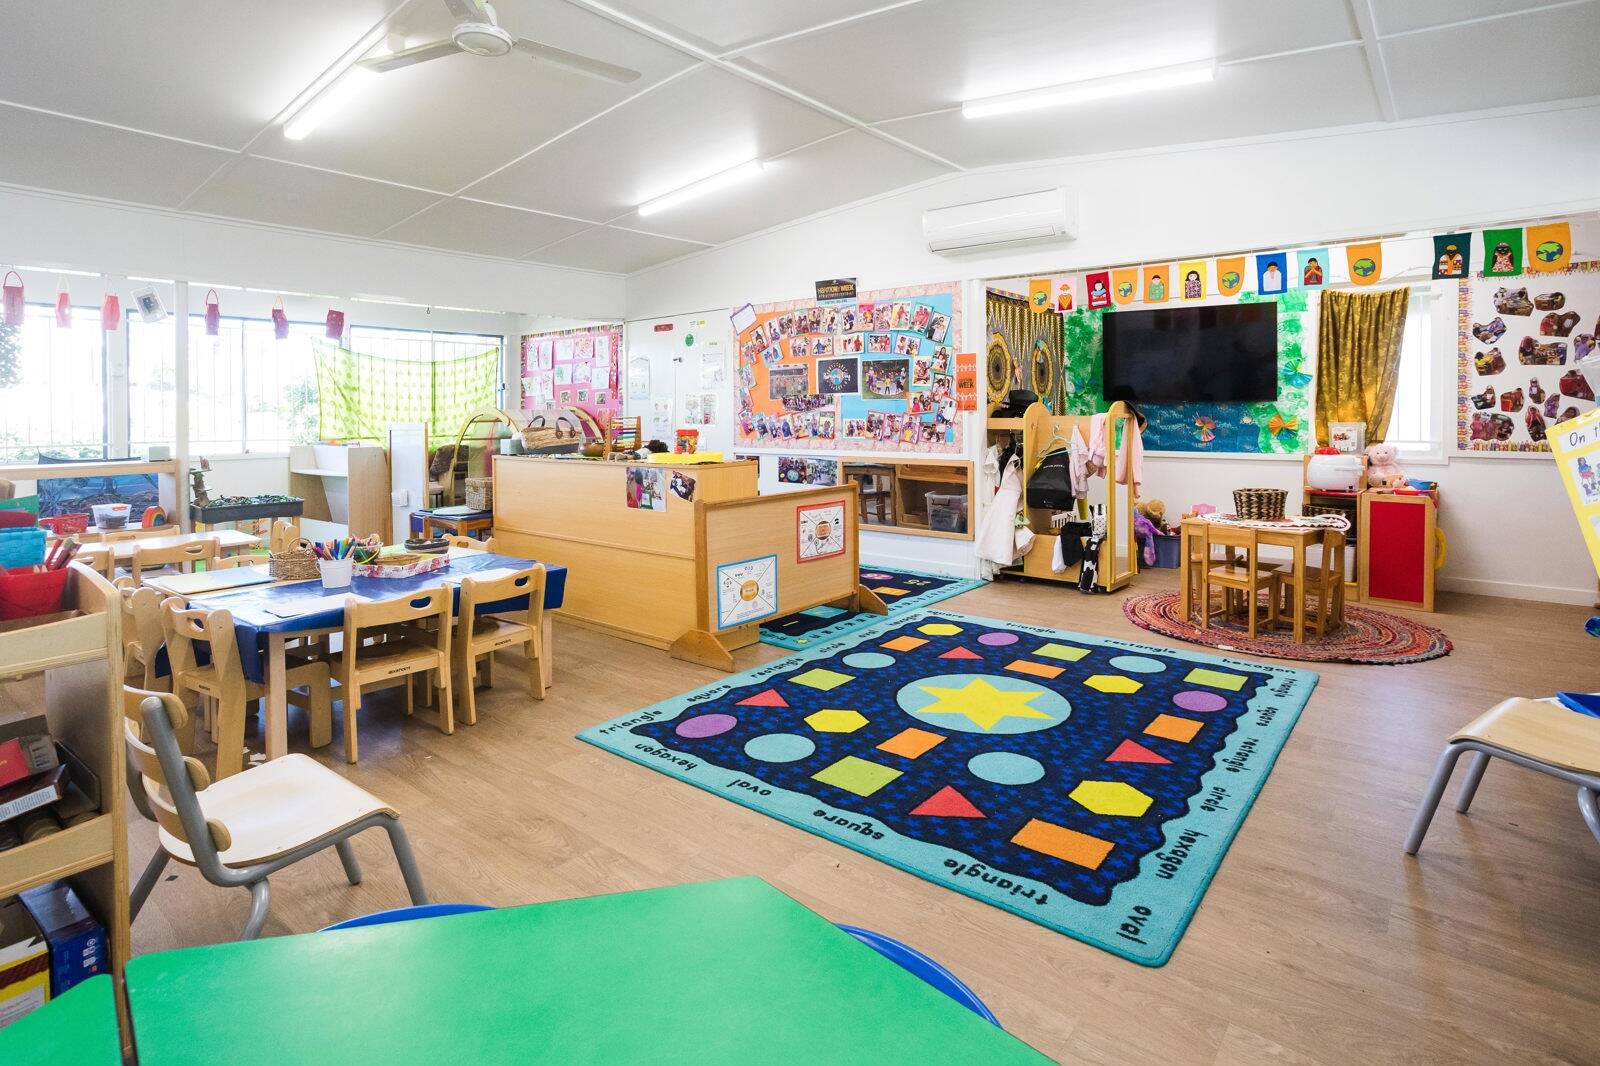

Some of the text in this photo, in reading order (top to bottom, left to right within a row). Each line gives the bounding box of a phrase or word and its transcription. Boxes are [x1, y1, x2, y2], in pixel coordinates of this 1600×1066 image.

[1569, 432, 1586, 447] On
[599, 709, 663, 736] triangle
[686, 684, 732, 703] square
[750, 657, 804, 680] rectangle
[819, 641, 846, 653] circle
[858, 629, 879, 639] oval
[886, 612, 922, 628] hexagon
[926, 610, 1296, 675] square triangle rectangle hexagon
[634, 742, 1049, 906] triangle square oval hexagon
[1116, 677, 1298, 945] triangle square rectangle circle hexagon oval
